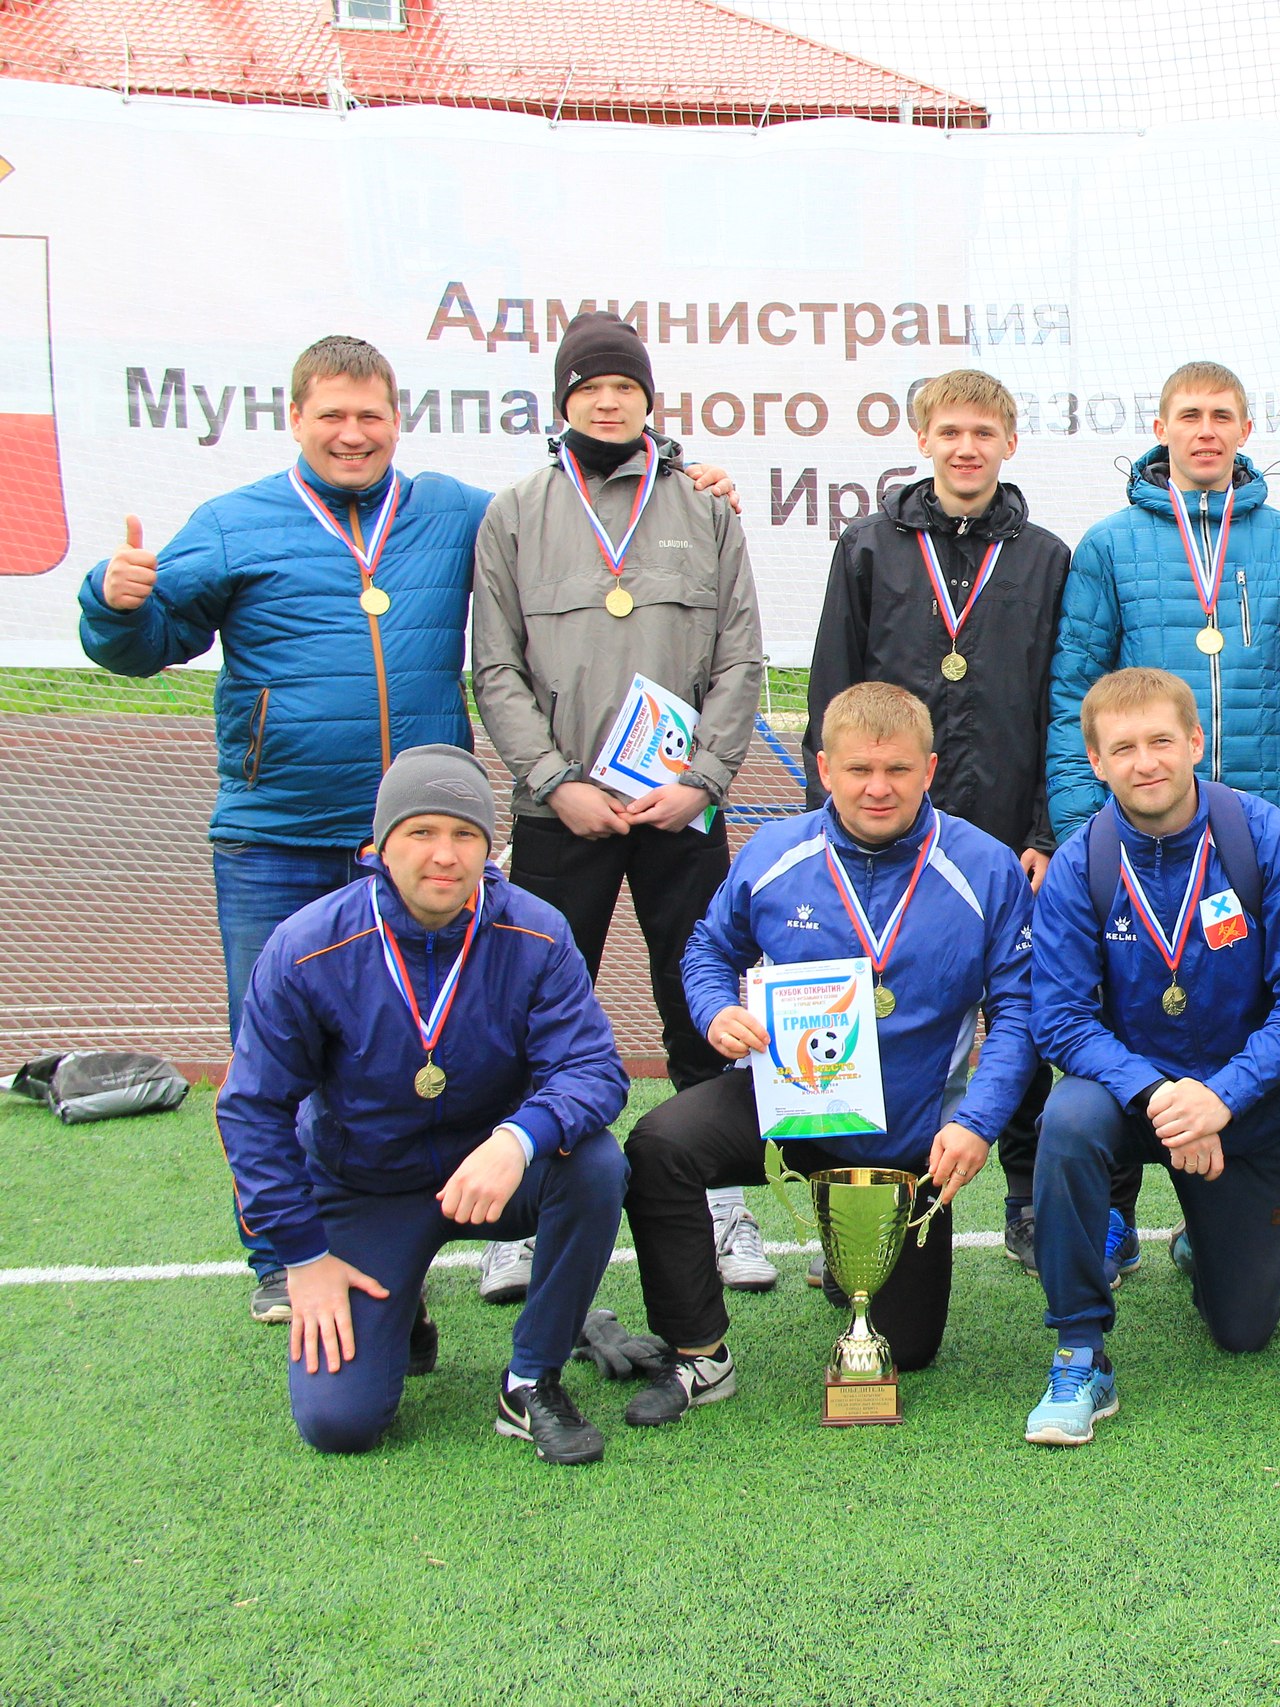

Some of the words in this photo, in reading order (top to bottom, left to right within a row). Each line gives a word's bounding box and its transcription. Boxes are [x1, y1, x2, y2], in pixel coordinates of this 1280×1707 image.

[126, 366, 829, 446] Мунипаного
[770, 466, 918, 541] Ирб
[640, 713, 670, 769] ГРАМОТА
[786, 919, 820, 930] KELME
[1105, 932, 1138, 942] KELME
[1015, 941, 1033, 951] KEL
[783, 1012, 850, 1032] ГРАМОТА
[776, 1066, 793, 1076] ЗА
[812, 1062, 856, 1074] МЕСТО
